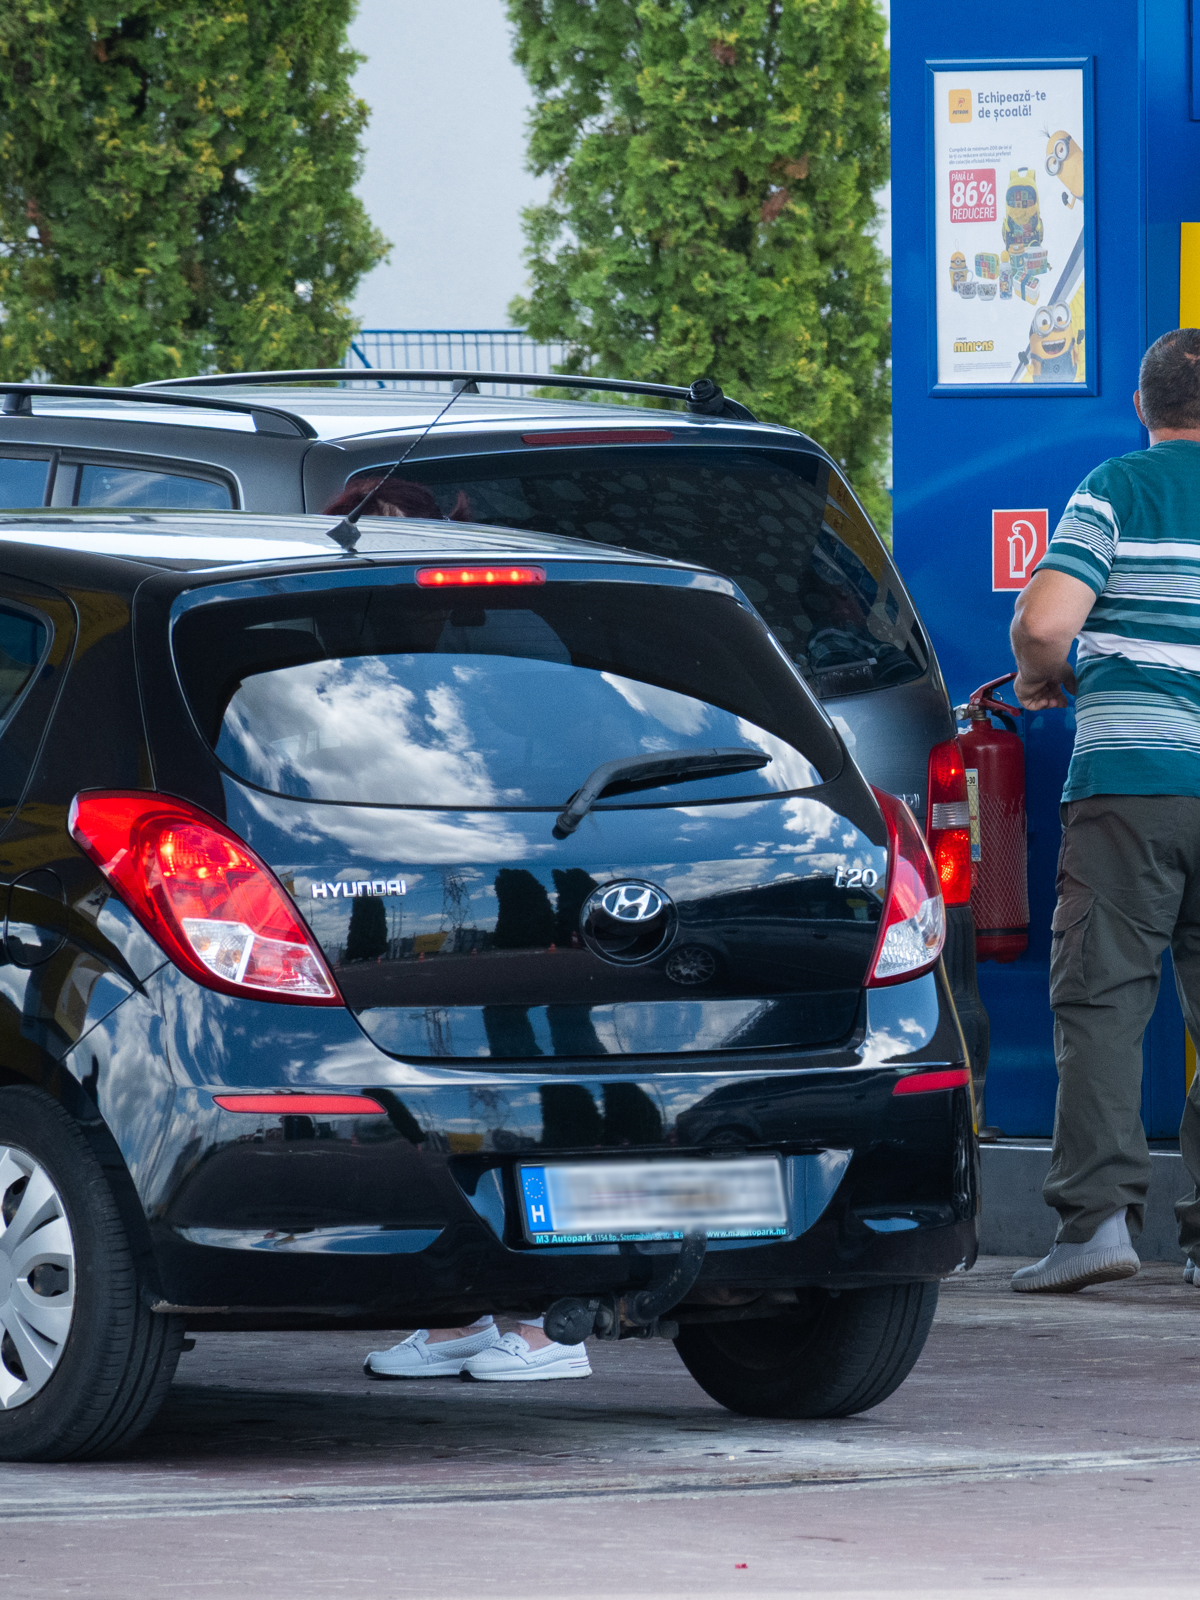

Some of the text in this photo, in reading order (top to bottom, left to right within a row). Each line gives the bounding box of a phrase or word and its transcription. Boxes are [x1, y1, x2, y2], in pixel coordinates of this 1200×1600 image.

[978, 89, 1046, 106] Echipează-te
[978, 104, 1032, 122] de școală!
[952, 171, 974, 181] PÂNĂ LA
[952, 180, 995, 208] 86%
[952, 206, 995, 220] REDUCERE
[834, 864, 878, 890] i20
[311, 878, 407, 899] HYUNDAI
[531, 1204, 545, 1223] H
[536, 1235, 550, 1244] M3
[551, 1234, 592, 1244] Autopark
